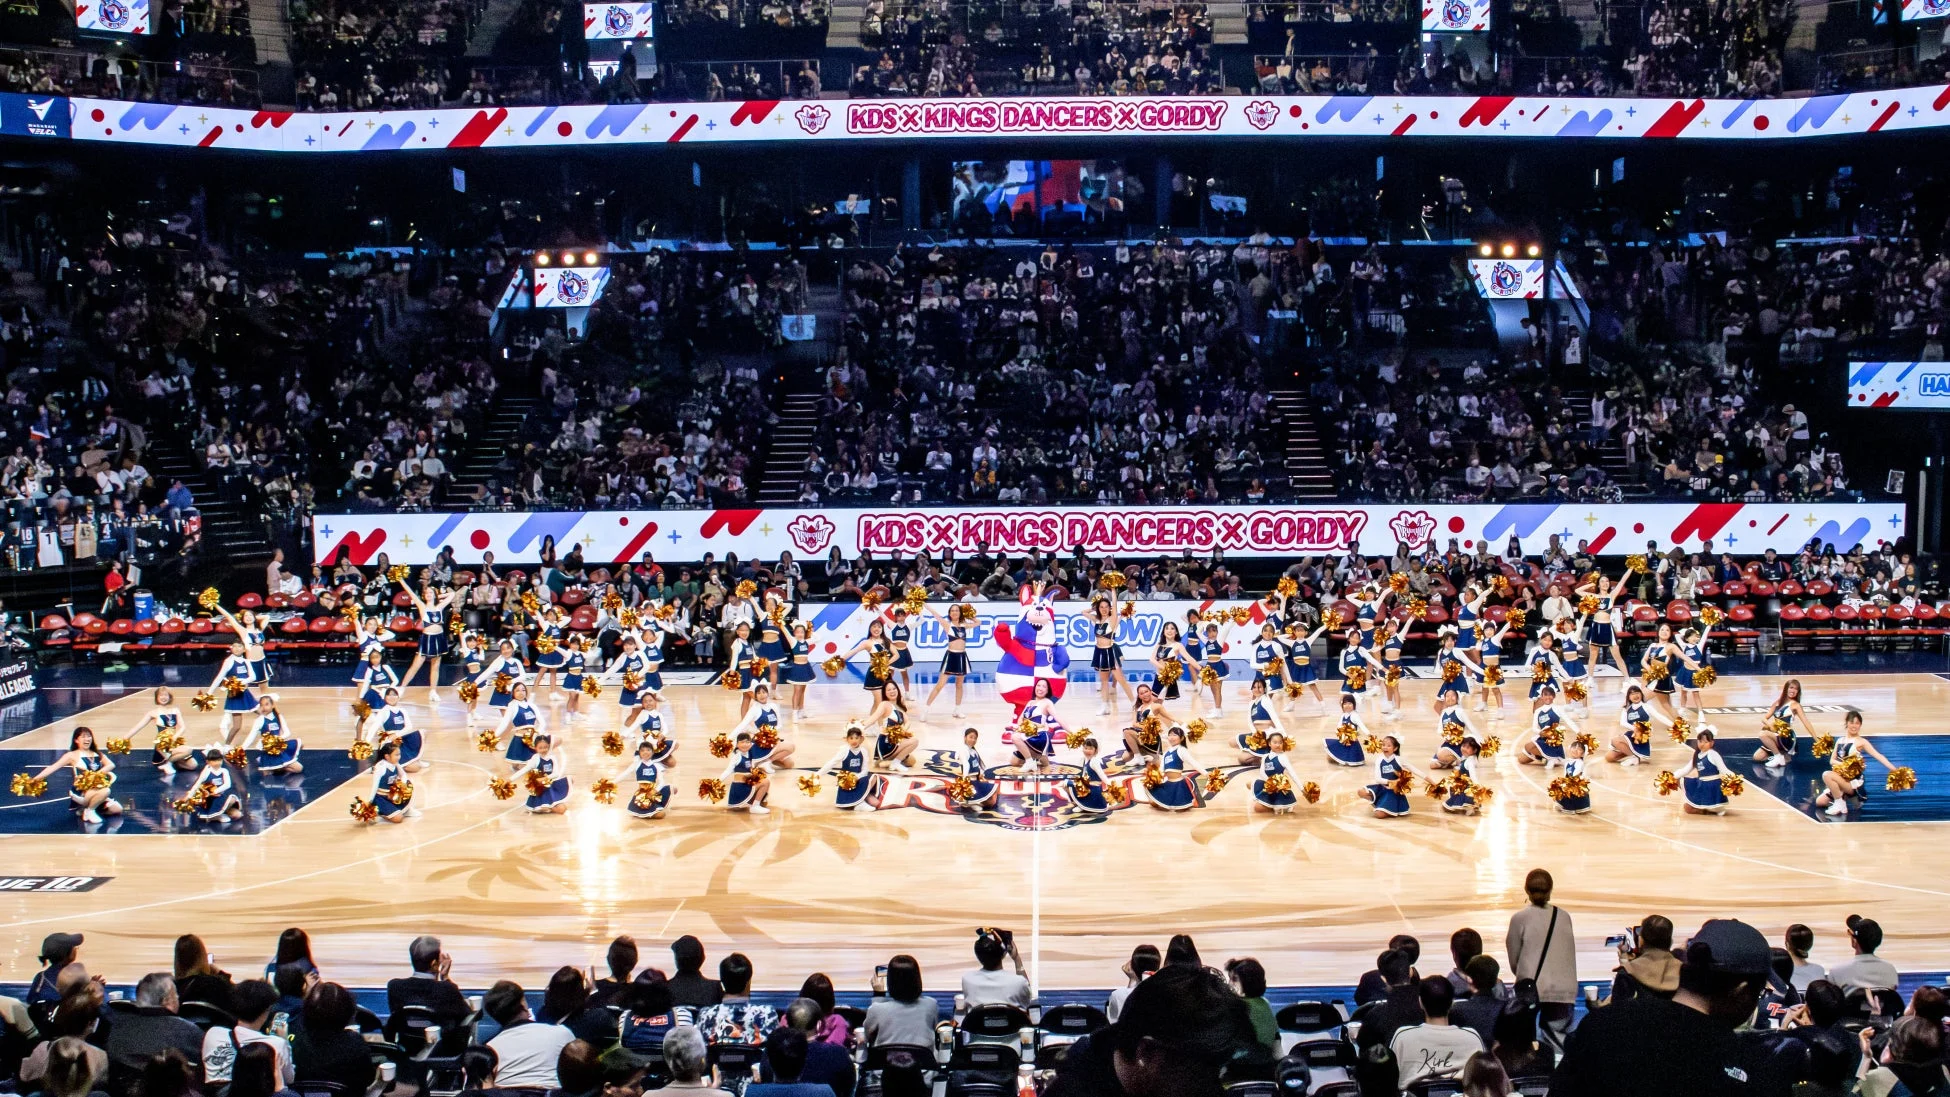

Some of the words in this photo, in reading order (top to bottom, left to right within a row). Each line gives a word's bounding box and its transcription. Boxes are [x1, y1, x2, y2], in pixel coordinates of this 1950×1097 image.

[851, 107, 898, 129] KDS
[924, 106, 997, 127] KINGS
[1003, 105, 1113, 127] DANCERS
[1140, 105, 1224, 126] GORDY
[1922, 376, 1950, 393] HA
[863, 519, 925, 548] KDS
[961, 518, 1059, 547] KINGS
[1067, 517, 1214, 546] DANCERS
[1250, 516, 1362, 545] GORDY
[1417, 1047, 1454, 1074] Kirk
